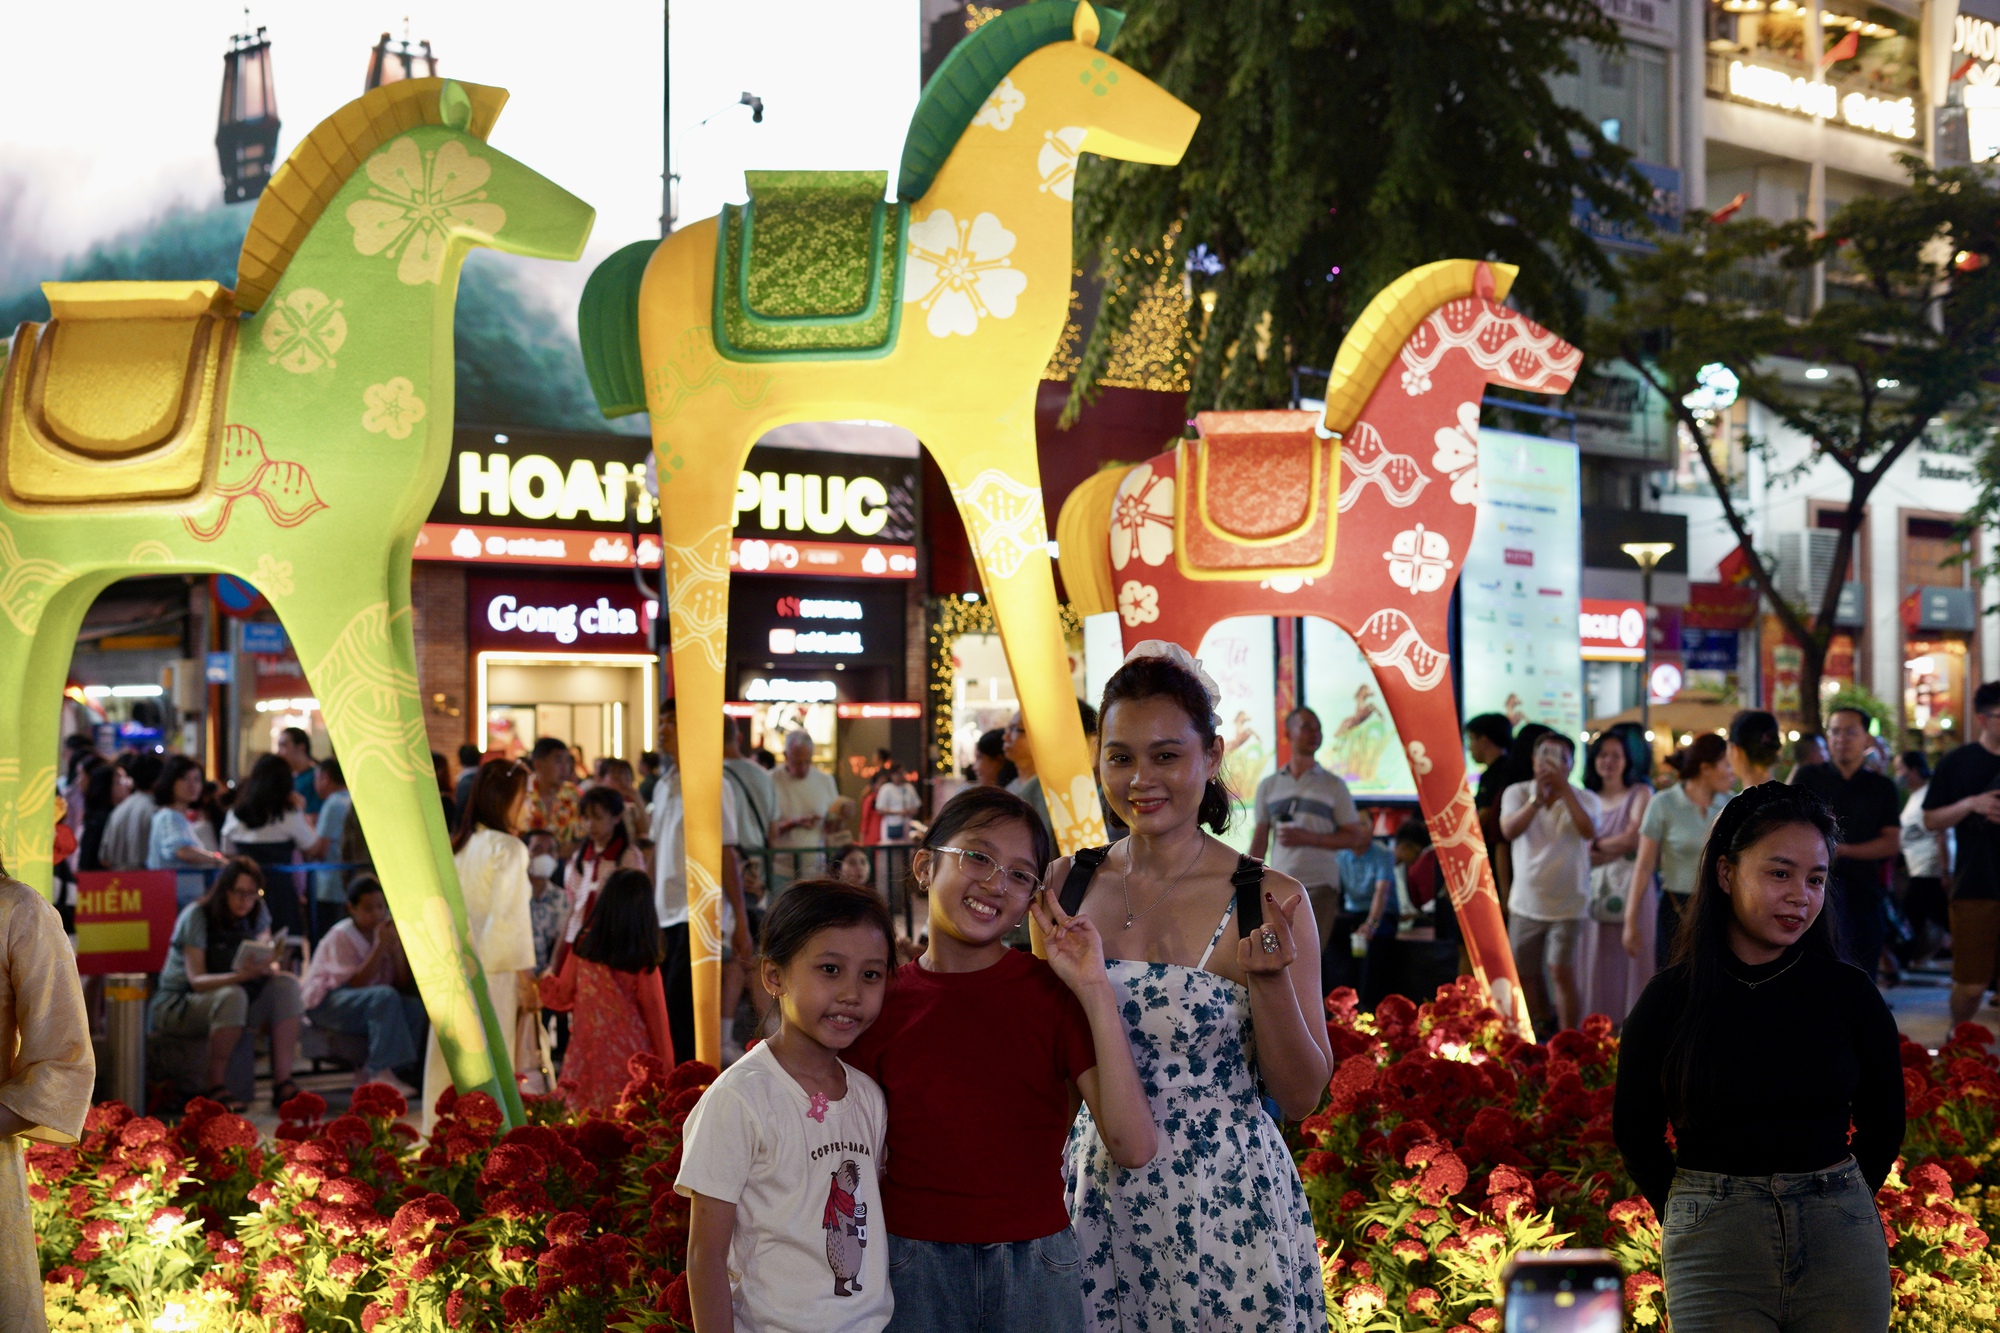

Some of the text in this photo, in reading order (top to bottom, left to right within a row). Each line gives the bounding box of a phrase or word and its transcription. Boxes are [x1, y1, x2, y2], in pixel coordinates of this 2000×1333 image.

[459, 451, 888, 536] HOAN PHUC
[488, 595, 638, 644] Gong cha
